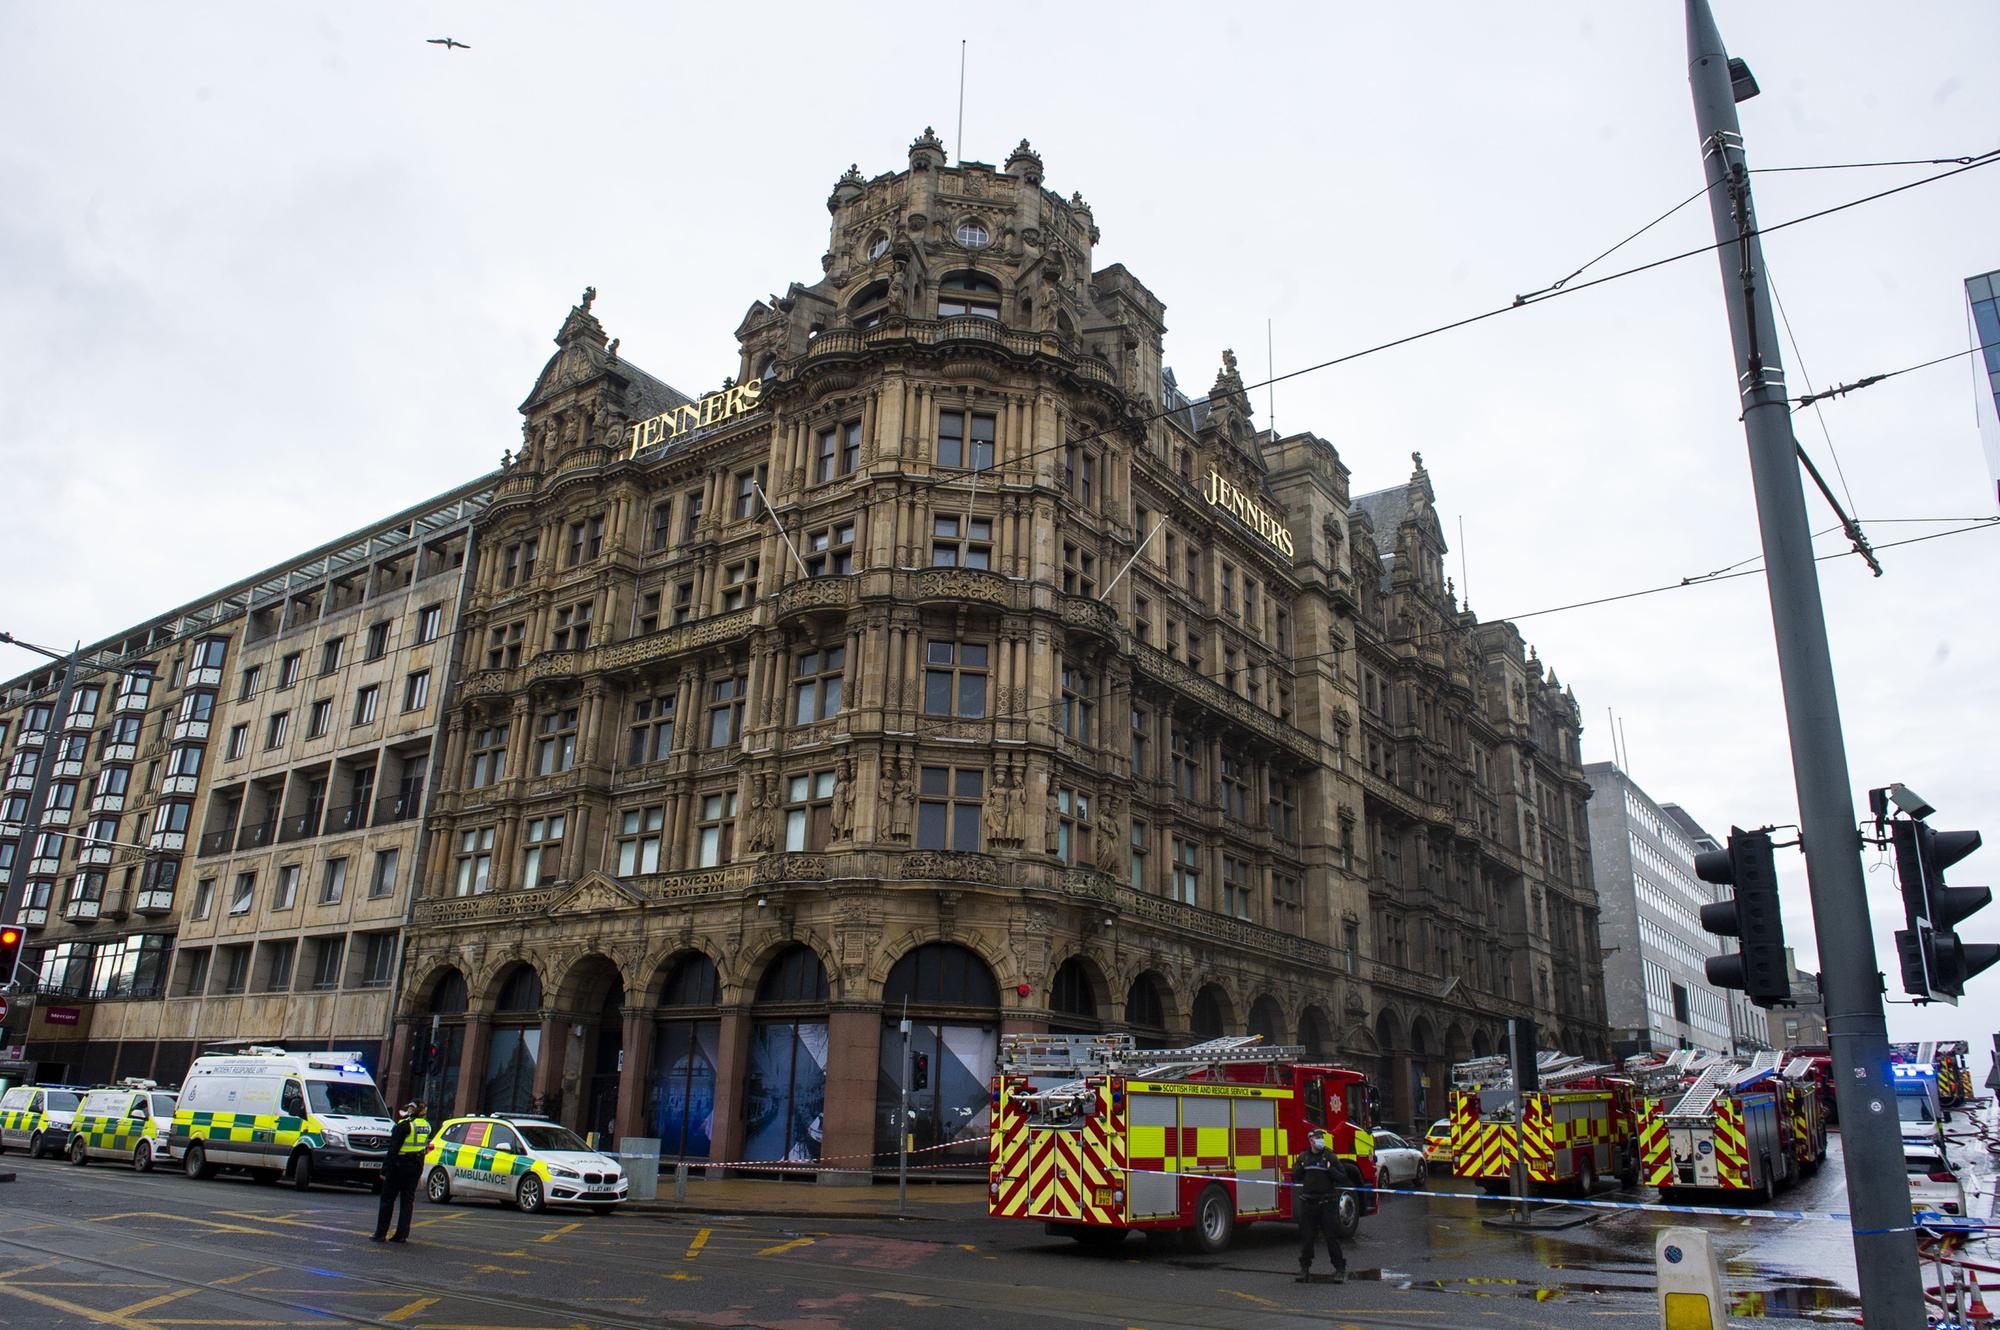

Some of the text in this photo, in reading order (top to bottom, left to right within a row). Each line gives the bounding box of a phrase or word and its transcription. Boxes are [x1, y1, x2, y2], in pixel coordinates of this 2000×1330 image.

[619, 377, 762, 461] JENNERS
[1203, 469, 1294, 557] JENNERS
[1162, 1084, 1249, 1096] SCOTTISH FIRE AND RESCUE SERVICE
[455, 1168, 507, 1185] AMBULANCE
